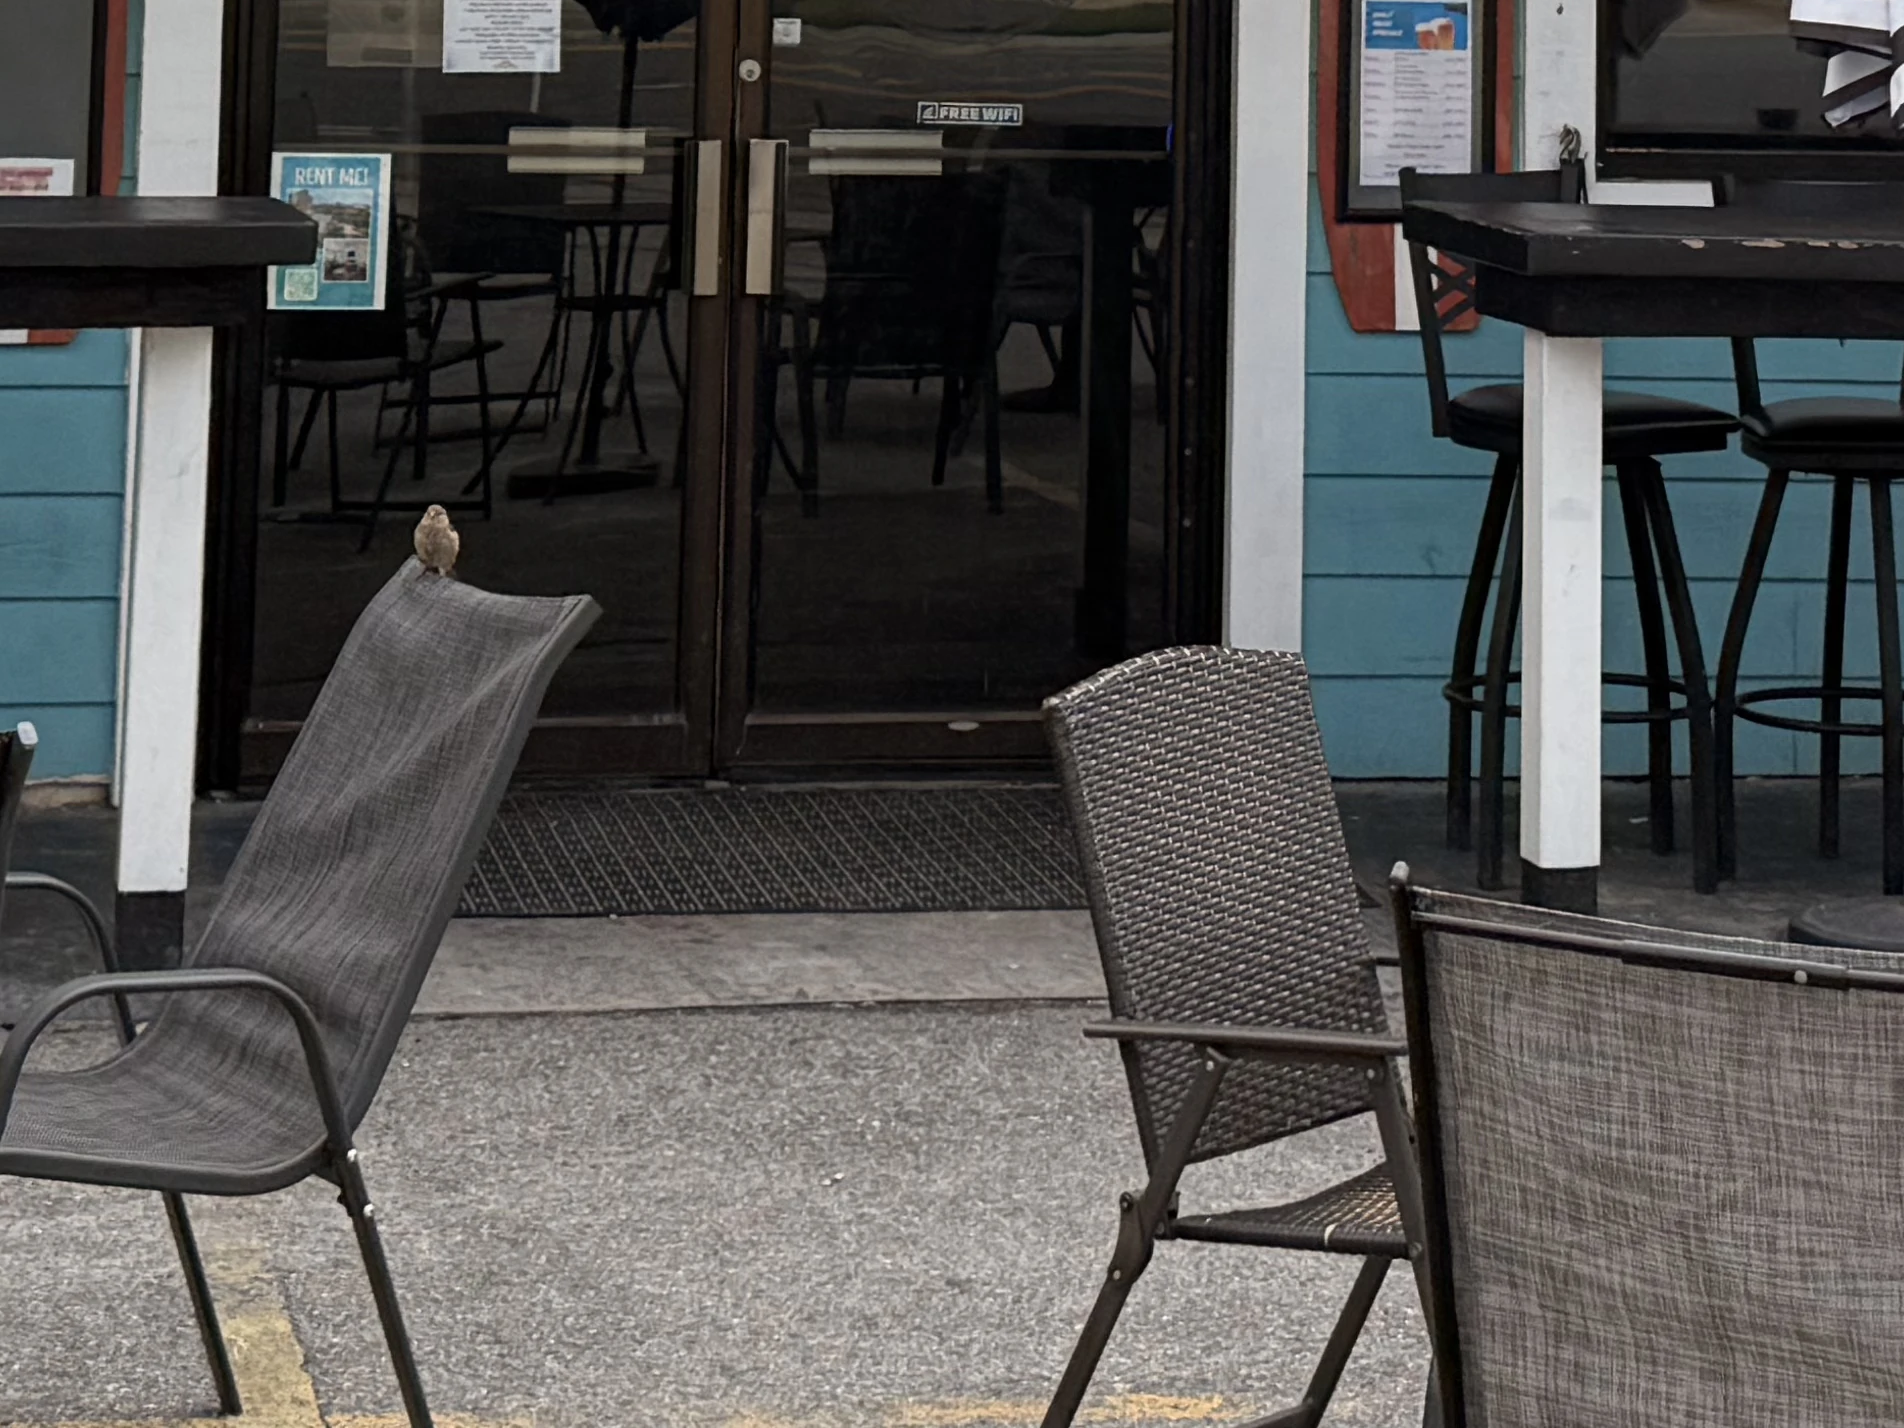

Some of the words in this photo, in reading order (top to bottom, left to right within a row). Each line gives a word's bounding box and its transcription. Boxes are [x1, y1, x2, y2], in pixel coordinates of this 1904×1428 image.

[940, 106, 980, 120] FREE
[982, 107, 1018, 121] WIFI
[295, 167, 333, 185] RENT
